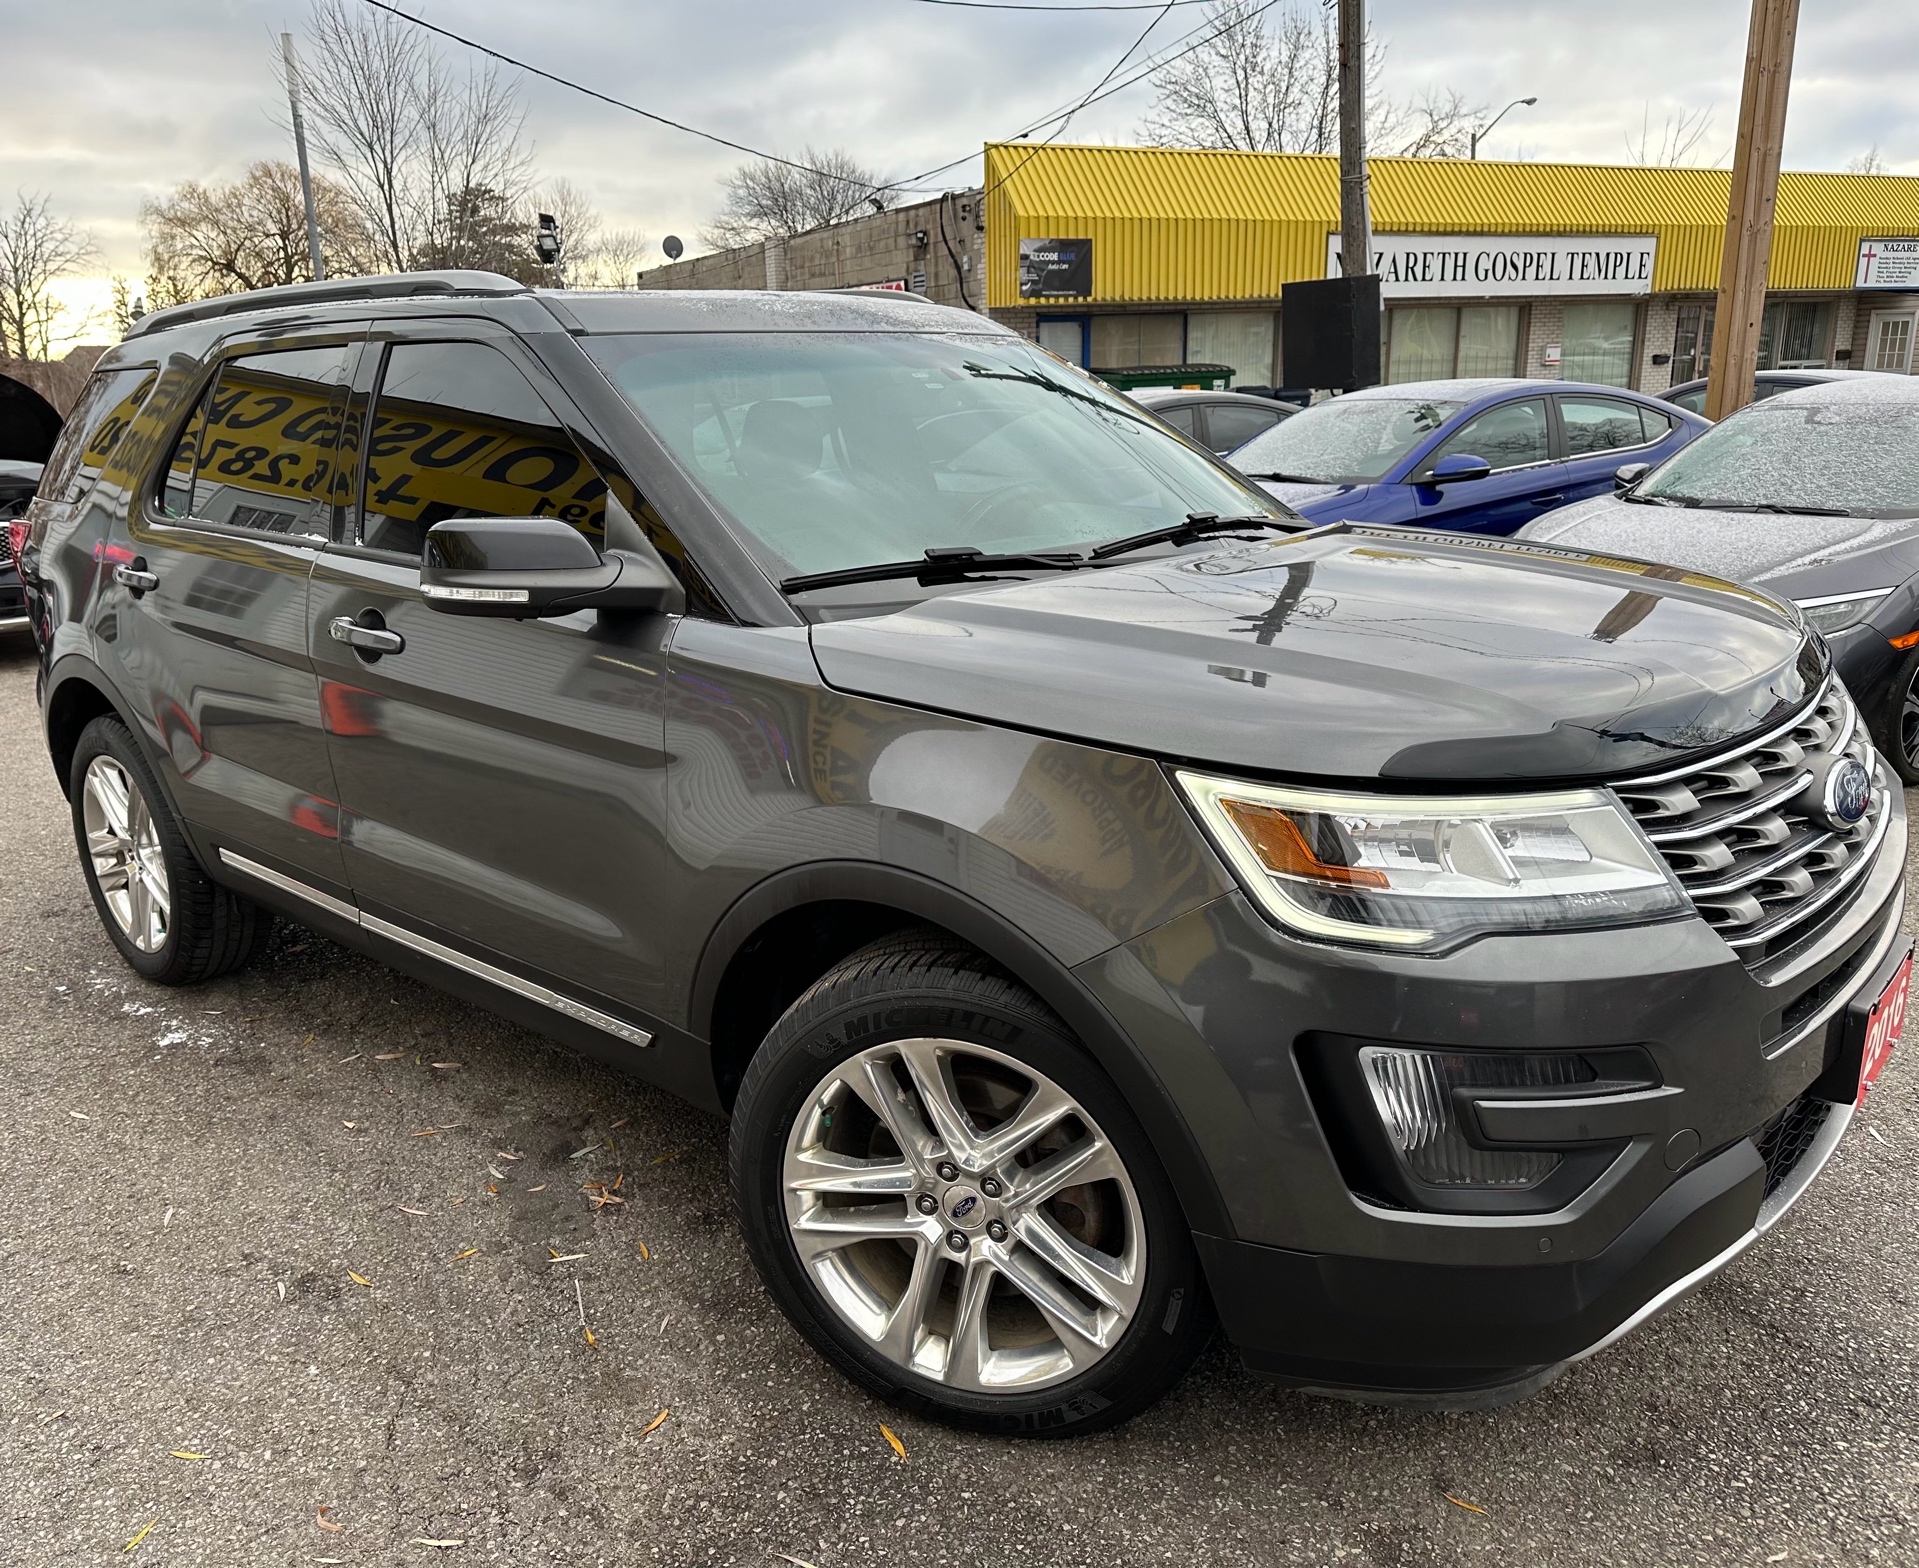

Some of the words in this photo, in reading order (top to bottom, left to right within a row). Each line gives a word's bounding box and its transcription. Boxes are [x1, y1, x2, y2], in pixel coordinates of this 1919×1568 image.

[1883, 244, 1919, 252] NAZARE
[1335, 251, 1469, 283] ZARETH
[1474, 251, 1561, 282] GOSPEL
[1566, 251, 1650, 281] TEMPLE
[554, 1001, 641, 1042] EXPLORER
[843, 1006, 1025, 1046] MICHELIN
[1862, 976, 1907, 1082] 2016
[954, 1199, 975, 1218] Ford
